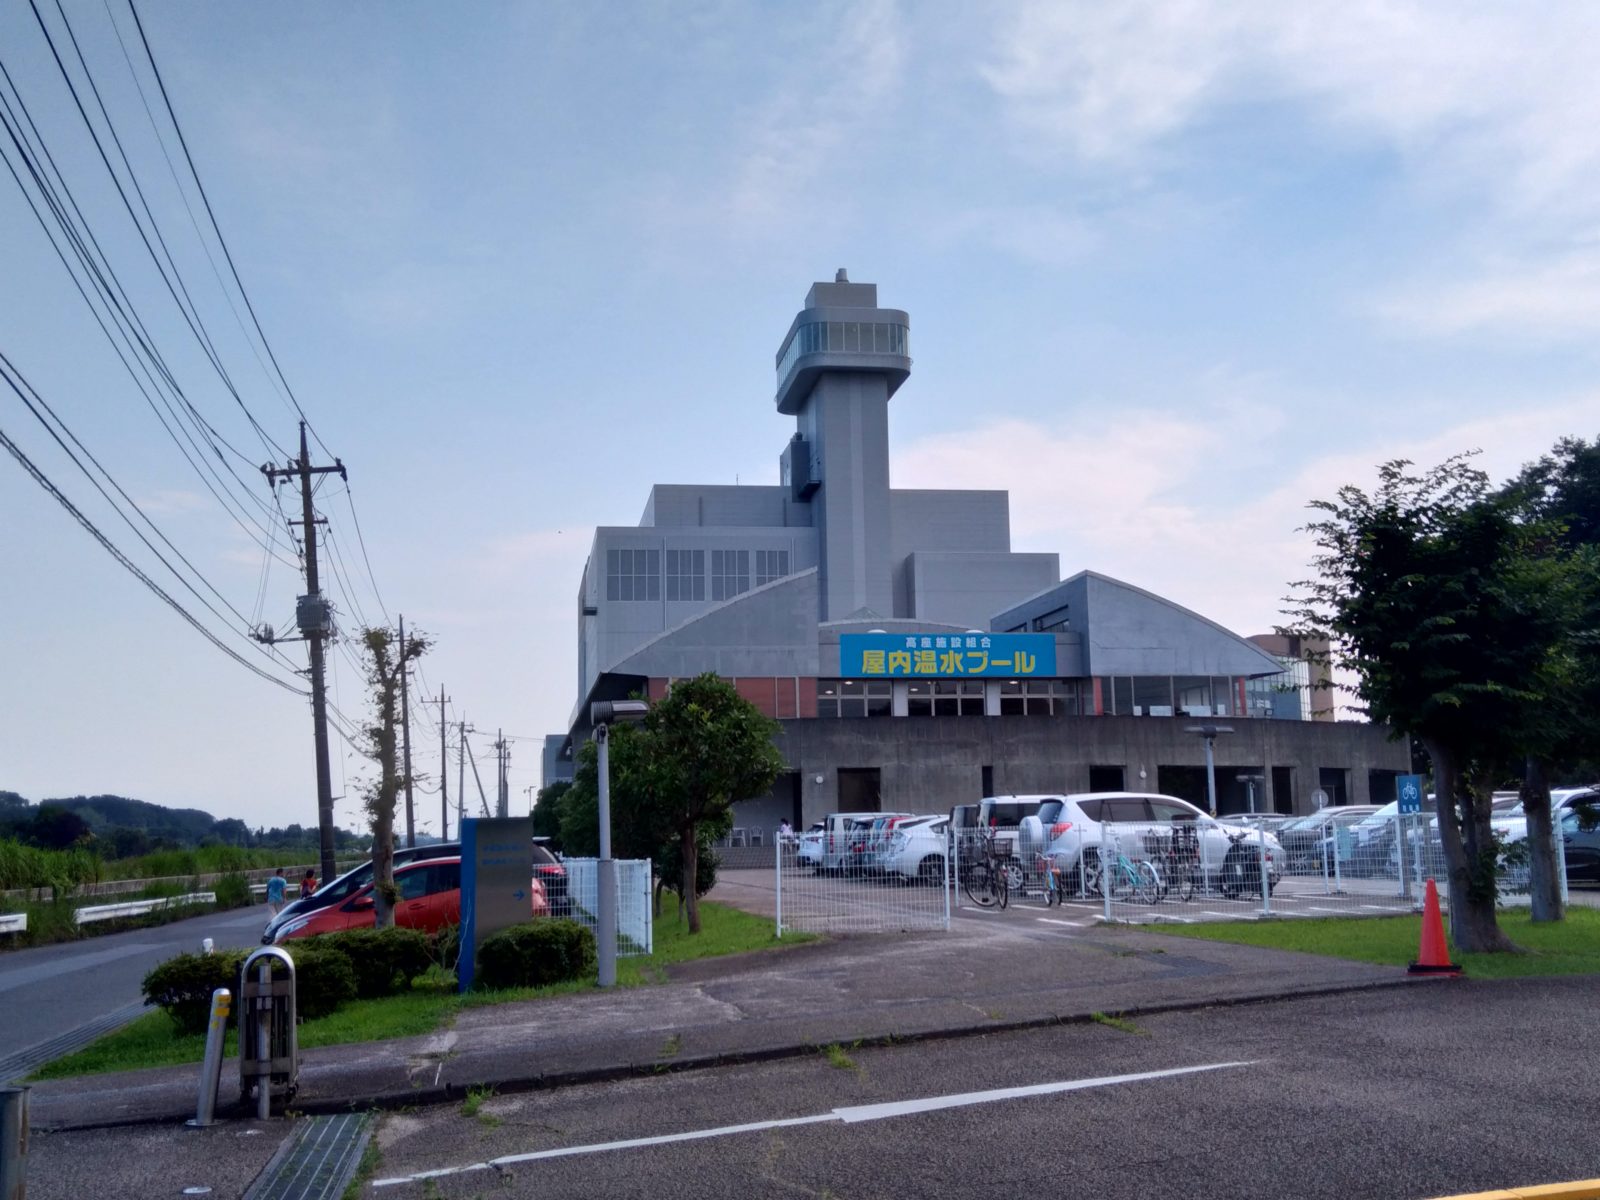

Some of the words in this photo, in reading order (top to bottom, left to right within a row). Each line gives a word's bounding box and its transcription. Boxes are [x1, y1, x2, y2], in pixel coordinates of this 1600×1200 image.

[905, 637, 992, 649] 高座施設組合
[862, 650, 1036, 674] 屋内温水プール
